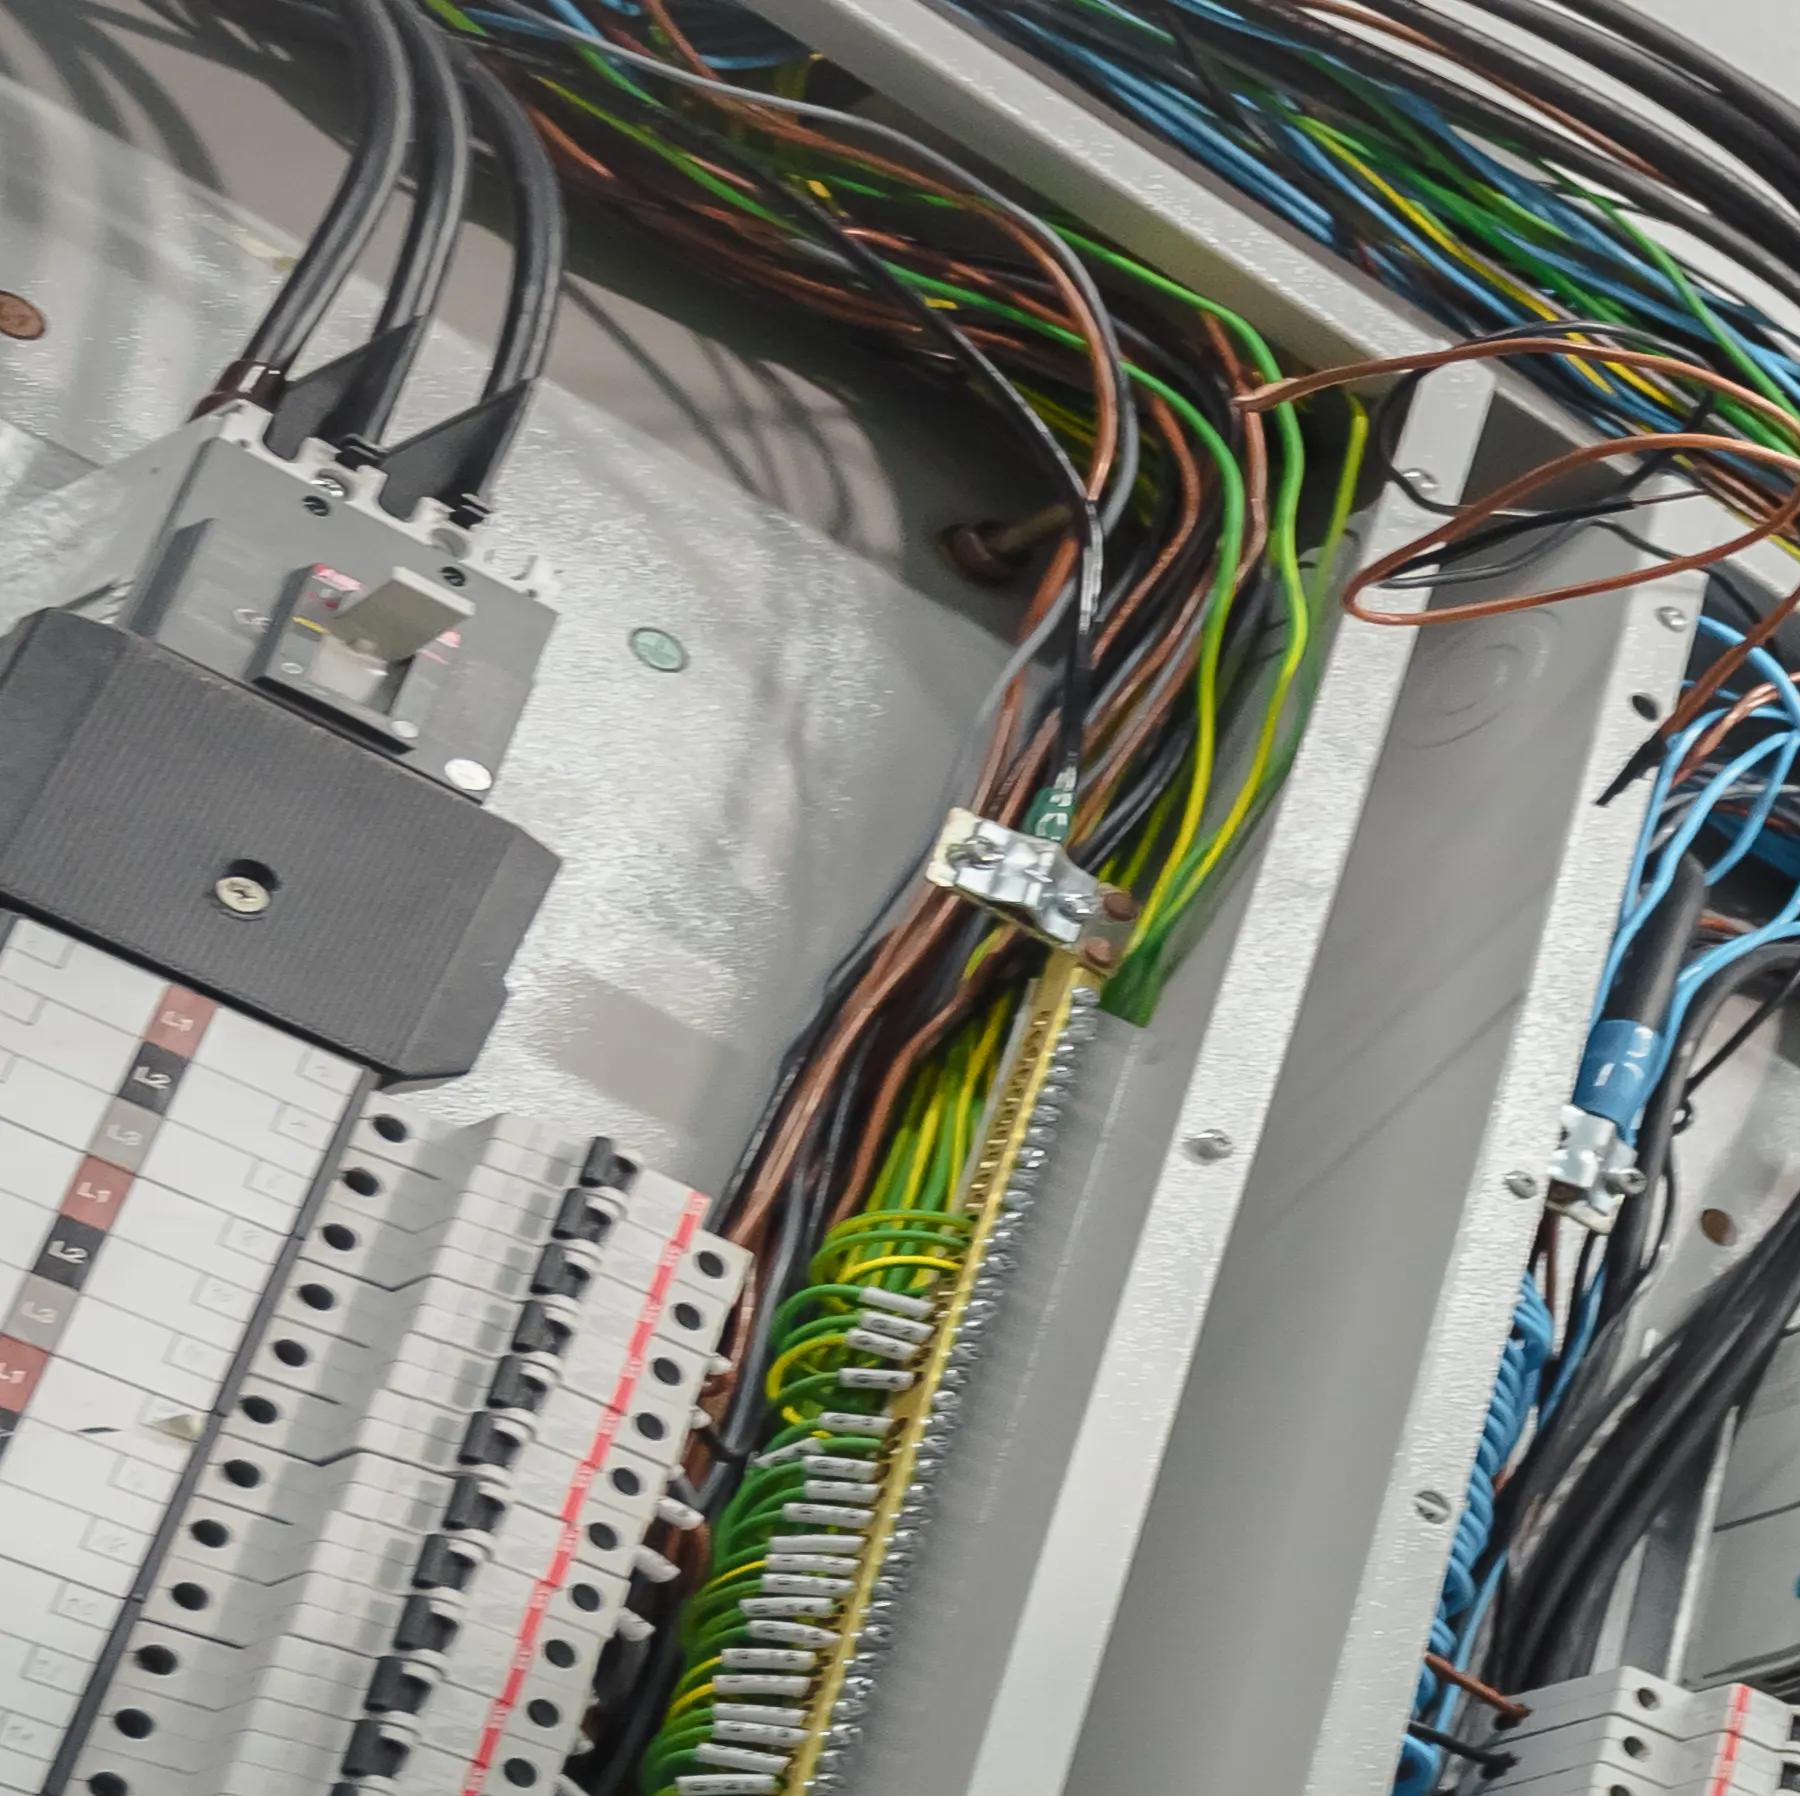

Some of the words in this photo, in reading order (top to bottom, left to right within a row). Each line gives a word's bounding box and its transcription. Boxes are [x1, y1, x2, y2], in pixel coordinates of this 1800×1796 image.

[160, 1010, 194, 1032] L1
[132, 1066, 172, 1089] L2
[105, 1124, 144, 1146] L3
[76, 1182, 112, 1203] L1
[47, 1240, 89, 1264] L2
[21, 1301, 58, 1324] L3
